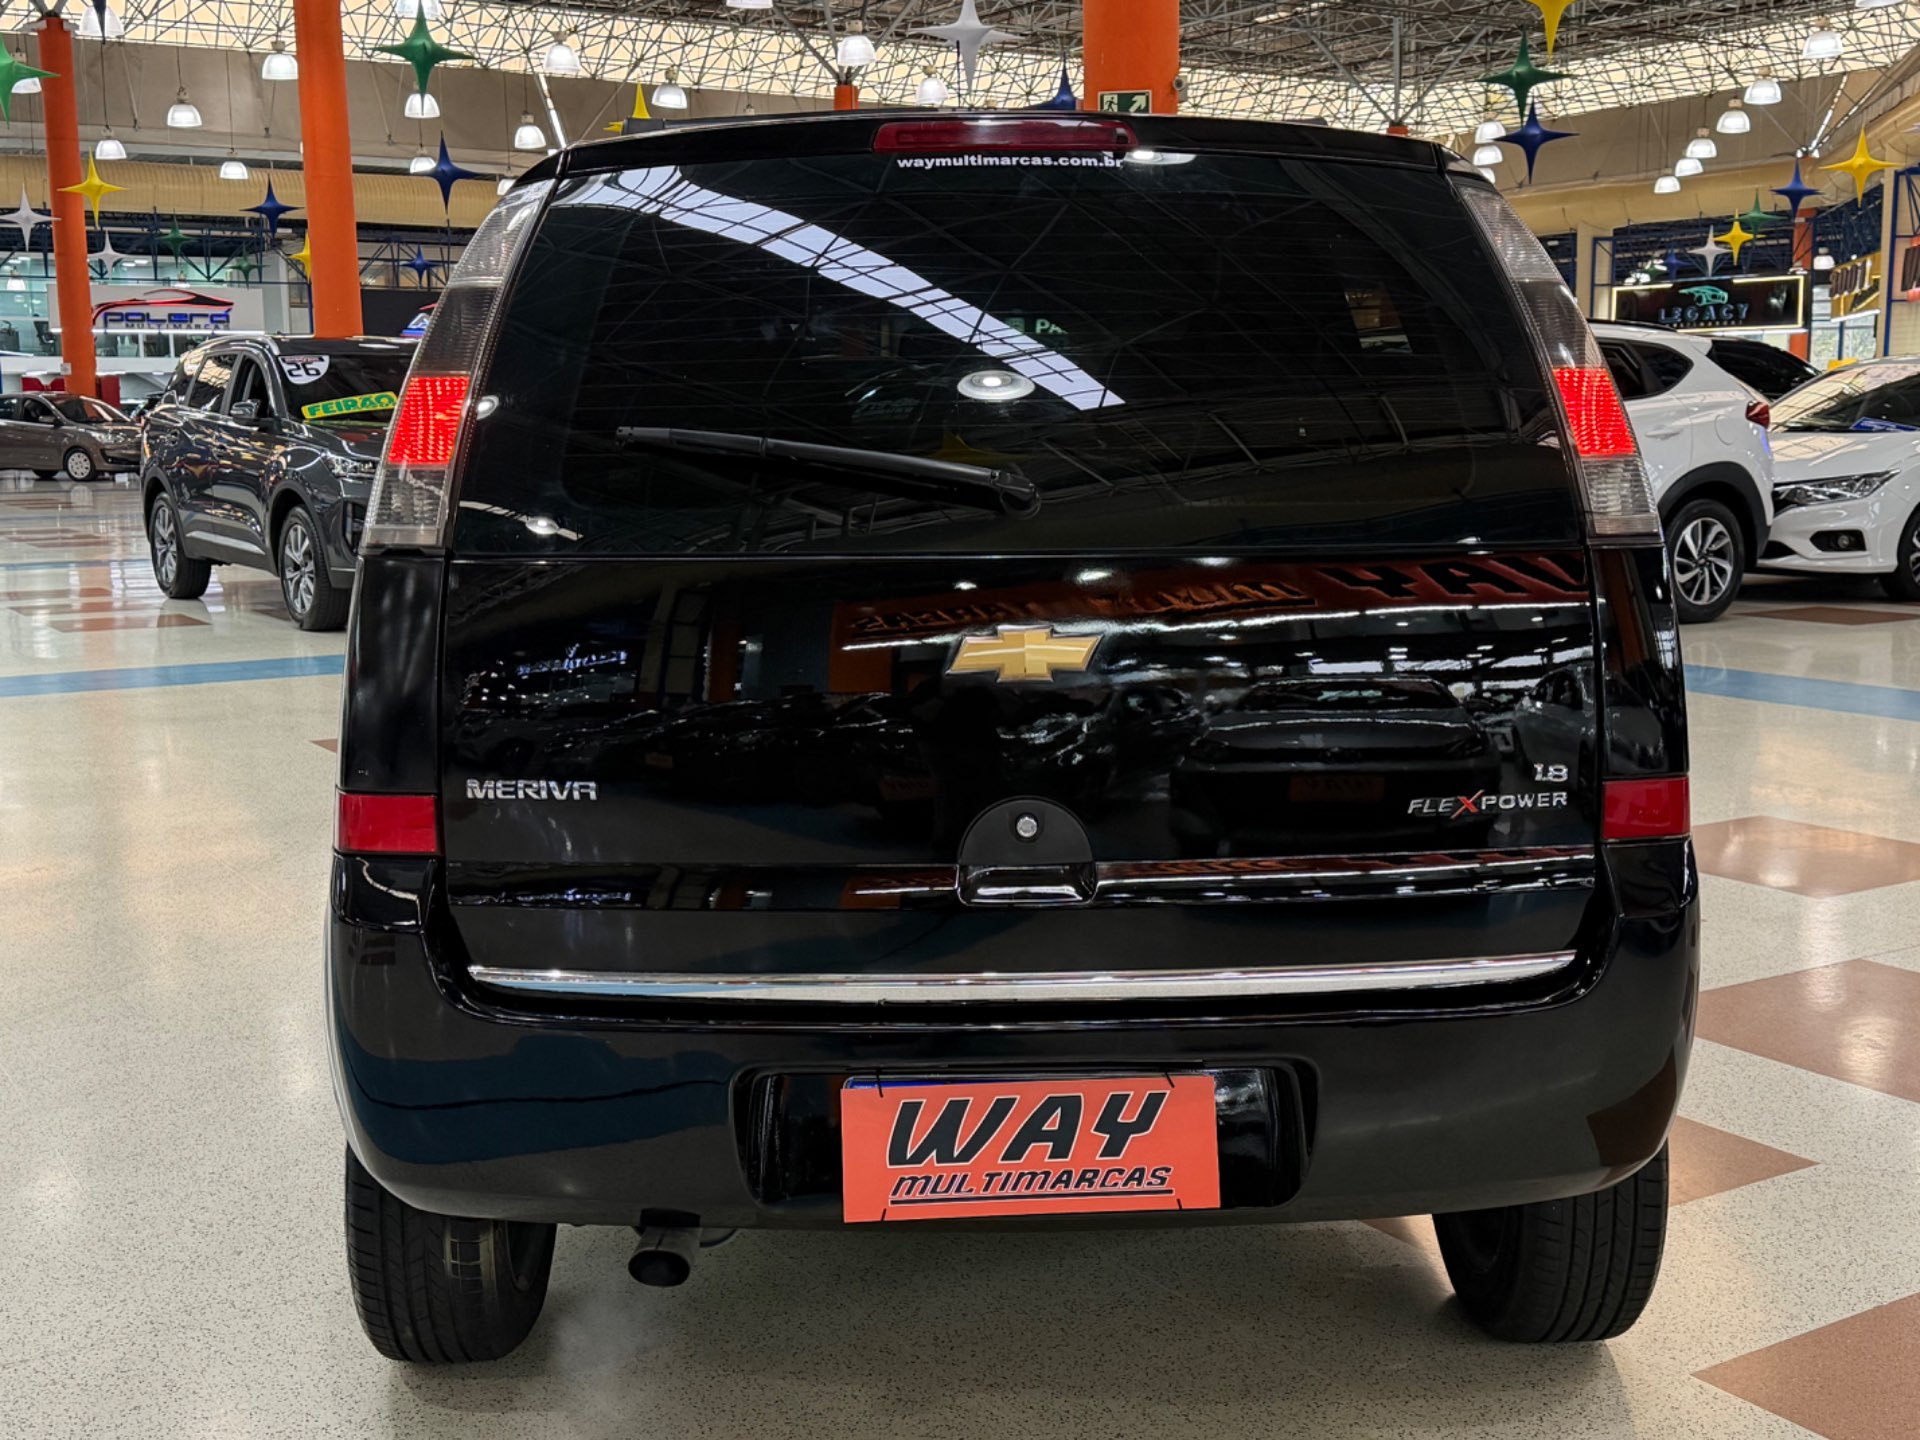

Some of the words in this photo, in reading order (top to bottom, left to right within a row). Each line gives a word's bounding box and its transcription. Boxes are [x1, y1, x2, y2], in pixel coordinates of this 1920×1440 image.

[897, 154, 1124, 169] waymultimarcas.com.br
[1659, 303, 1749, 323] LEGACY
[287, 362, 321, 377] 26
[466, 779, 597, 801] MERIVA
[1407, 789, 1568, 819] FLEXPOWER
[887, 1091, 1171, 1168] WAY
[891, 1166, 1174, 1197] MULTIMARCAS
